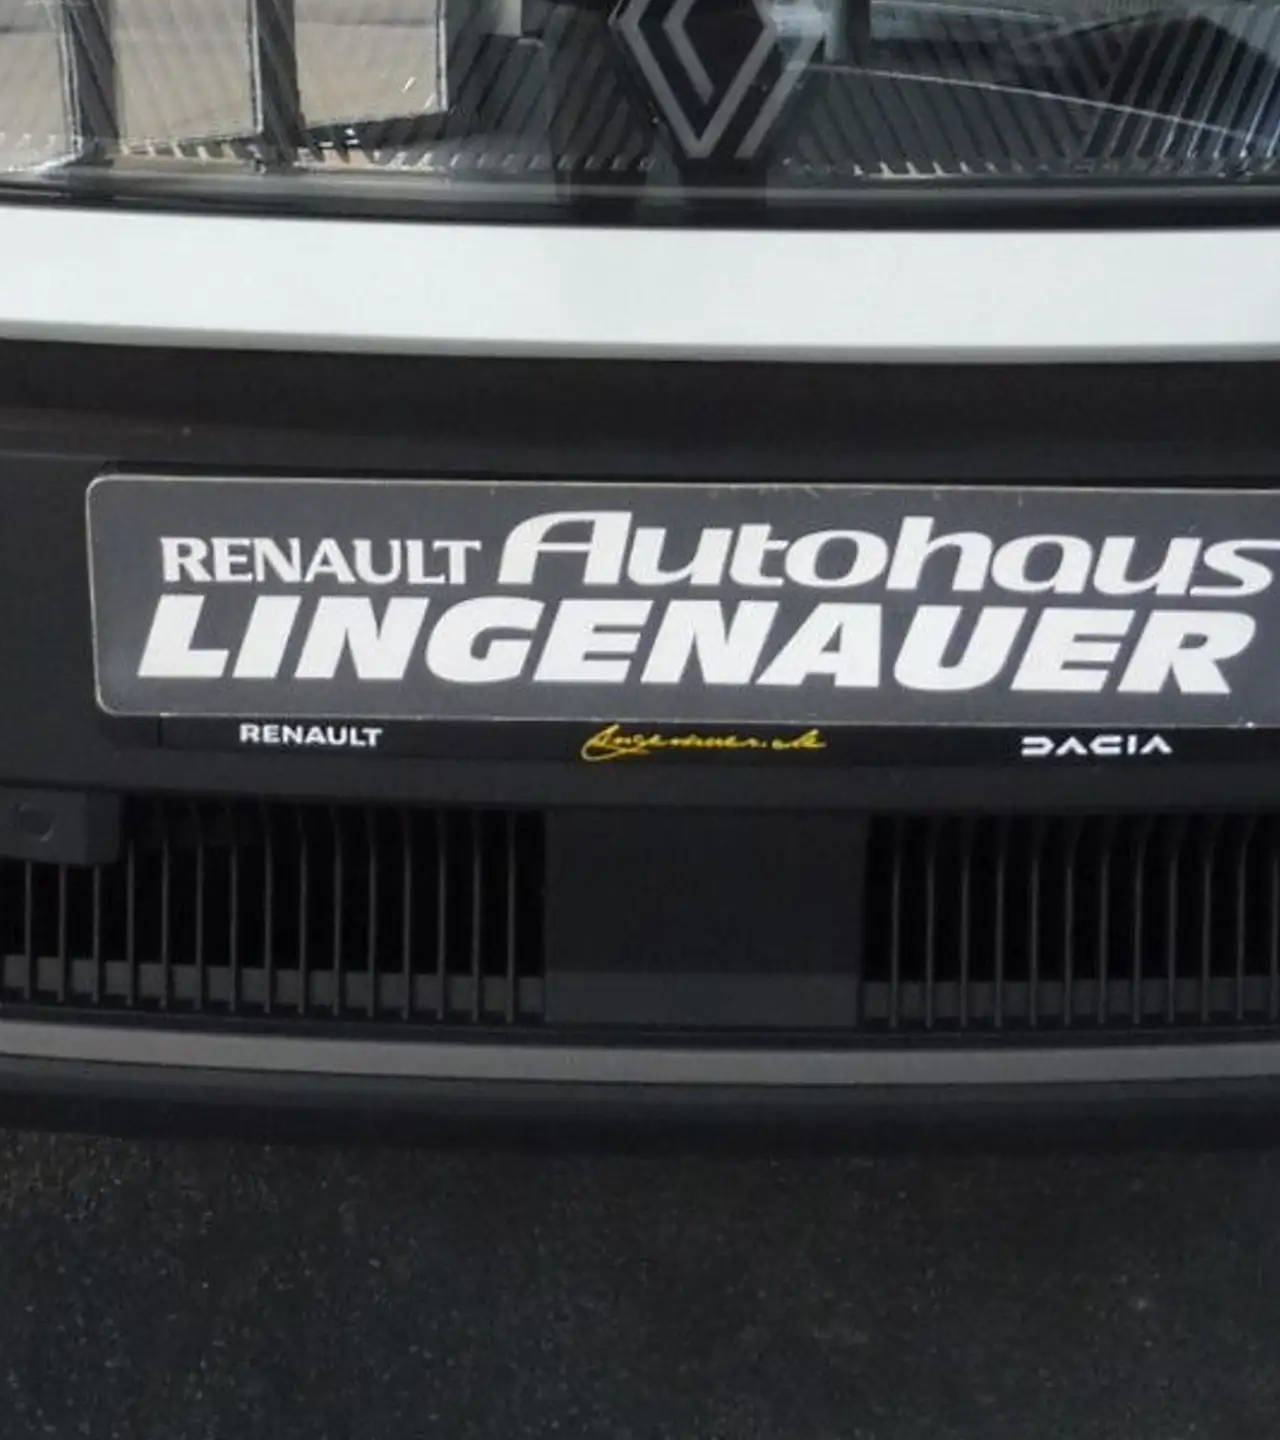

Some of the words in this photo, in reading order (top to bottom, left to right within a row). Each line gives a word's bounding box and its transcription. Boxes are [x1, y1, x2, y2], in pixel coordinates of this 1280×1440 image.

[160, 536, 483, 586] RENAULT
[137, 594, 1257, 695] LINGENAUER
[239, 723, 384, 748] RENAULT
[1021, 734, 1173, 757] DACIA
